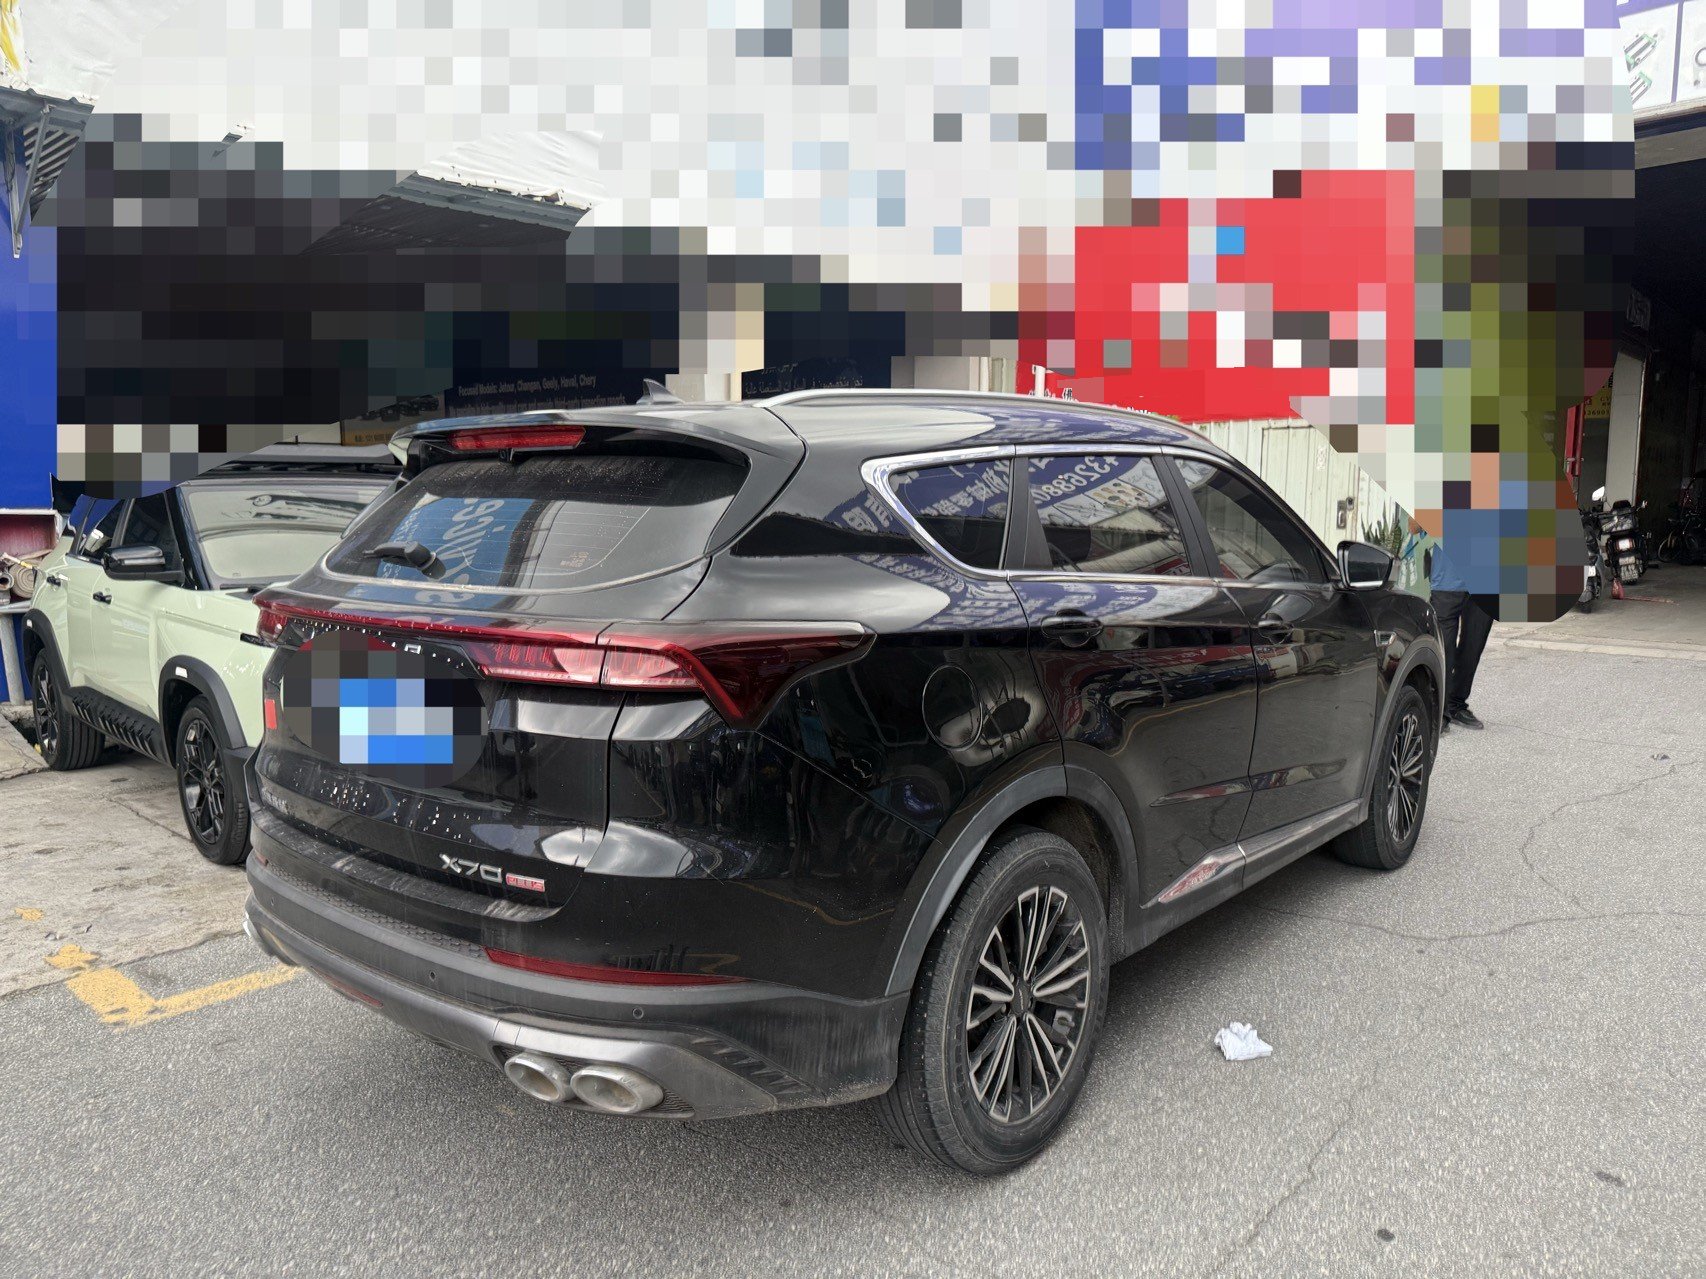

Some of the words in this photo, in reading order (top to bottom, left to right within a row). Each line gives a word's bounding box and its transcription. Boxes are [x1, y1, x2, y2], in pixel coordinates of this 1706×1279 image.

[542, 376, 560, 391] Geely,
[579, 374, 597, 389] Chery
[439, 853, 502, 883] X70
